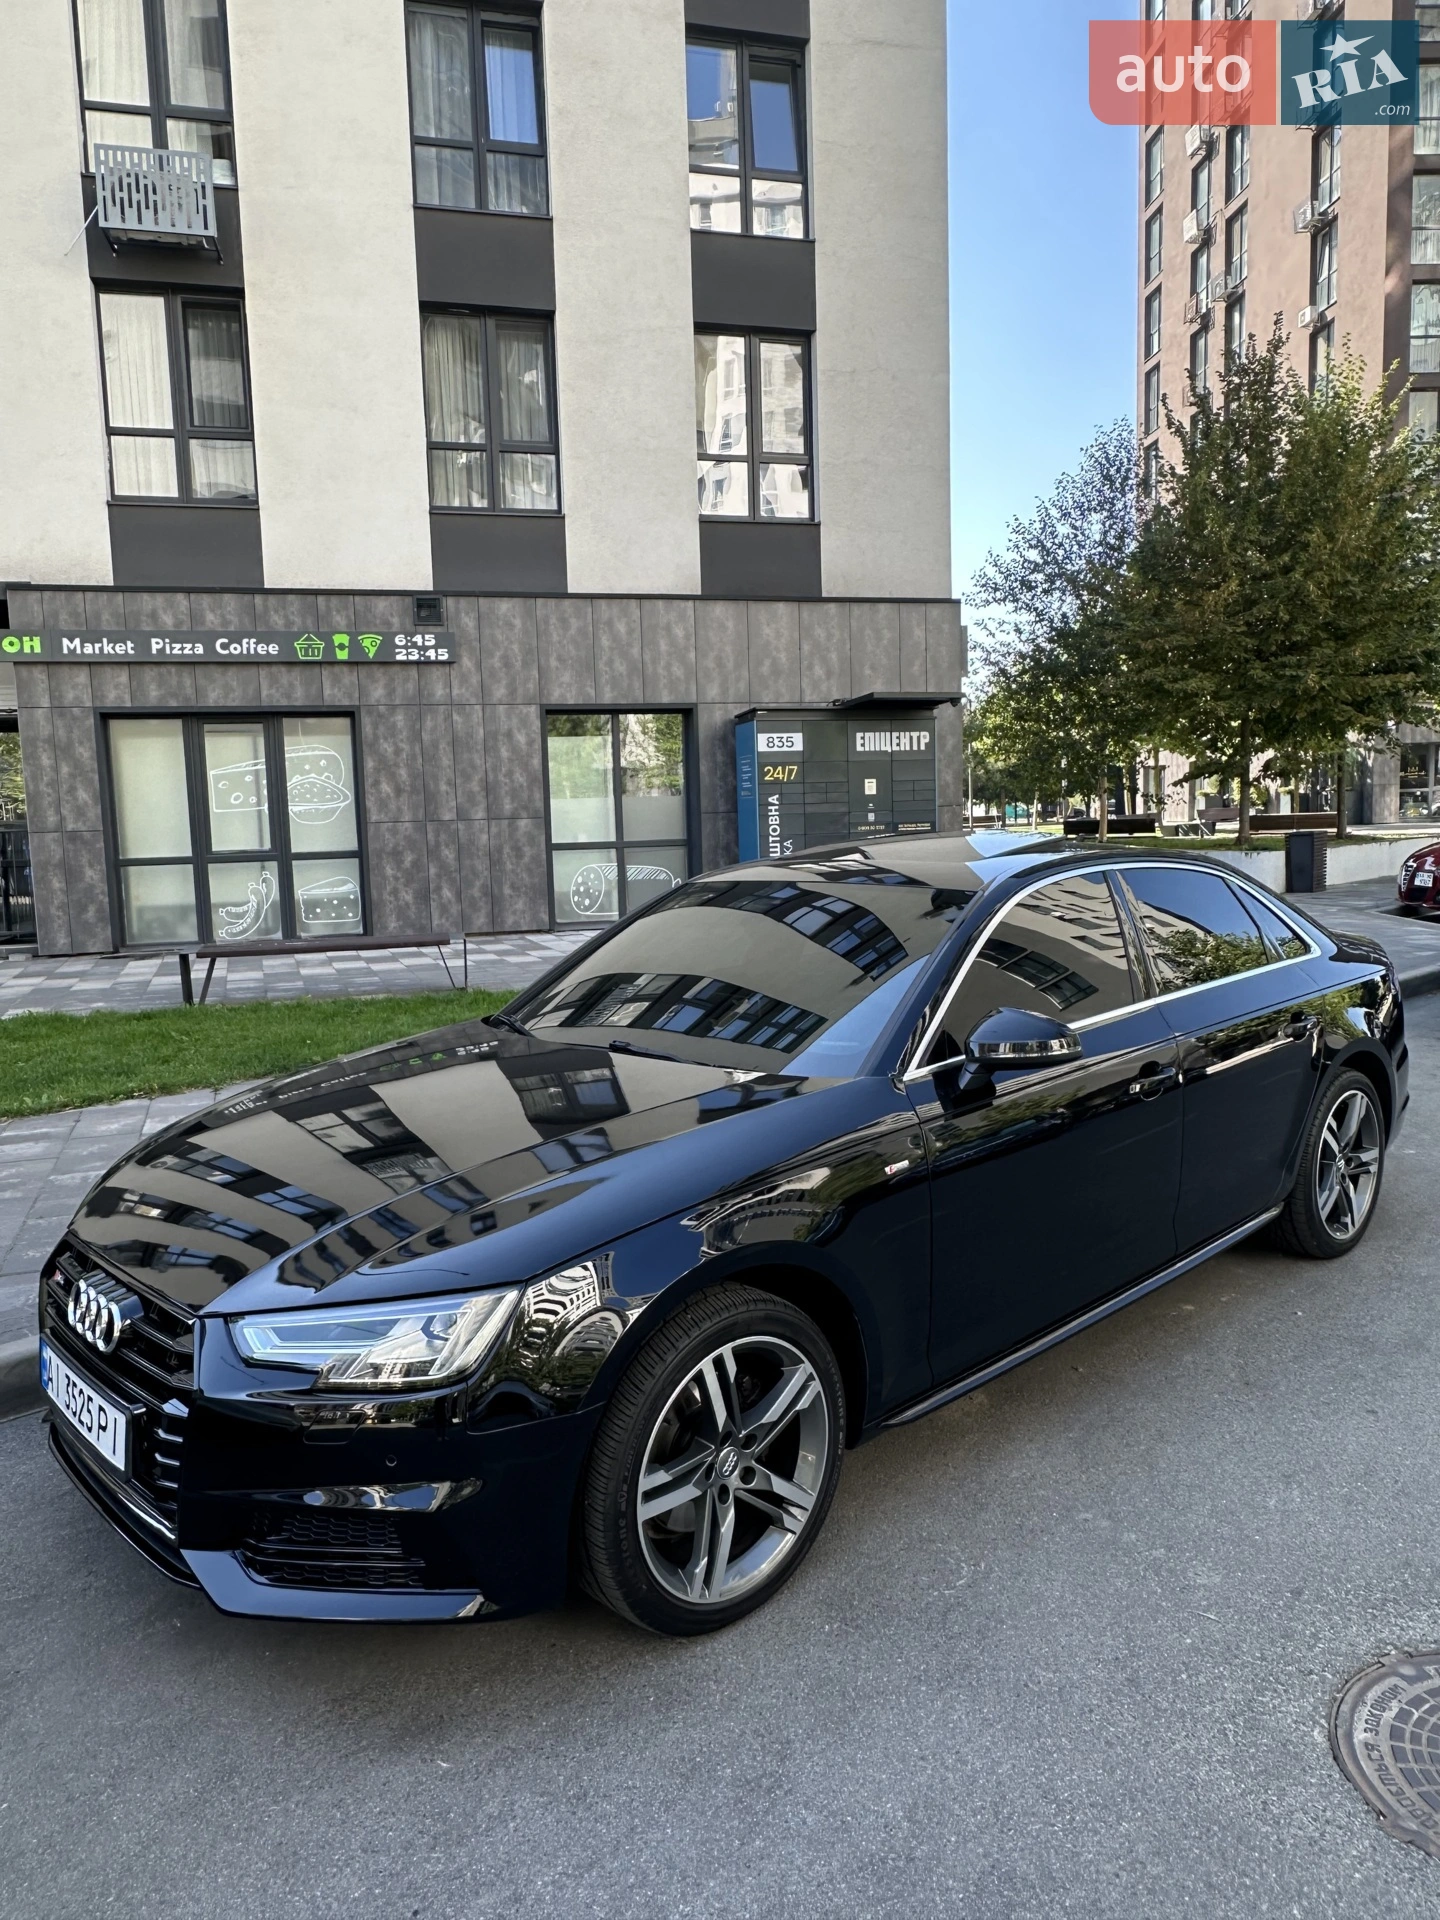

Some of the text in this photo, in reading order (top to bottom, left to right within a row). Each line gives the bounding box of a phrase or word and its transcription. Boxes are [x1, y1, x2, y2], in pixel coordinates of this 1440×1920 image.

[62, 638, 135, 654] Market
[151, 638, 204, 655] Pizza
[215, 637, 279, 655] Coffee
[394, 634, 436, 646] 6:45
[395, 648, 449, 660] 23:45
[766, 736, 795, 749] 835
[856, 731, 930, 752] ЕПІЦЕНТР
[764, 765, 798, 781] 24/7
[64, 1374, 94, 1433] 3525
